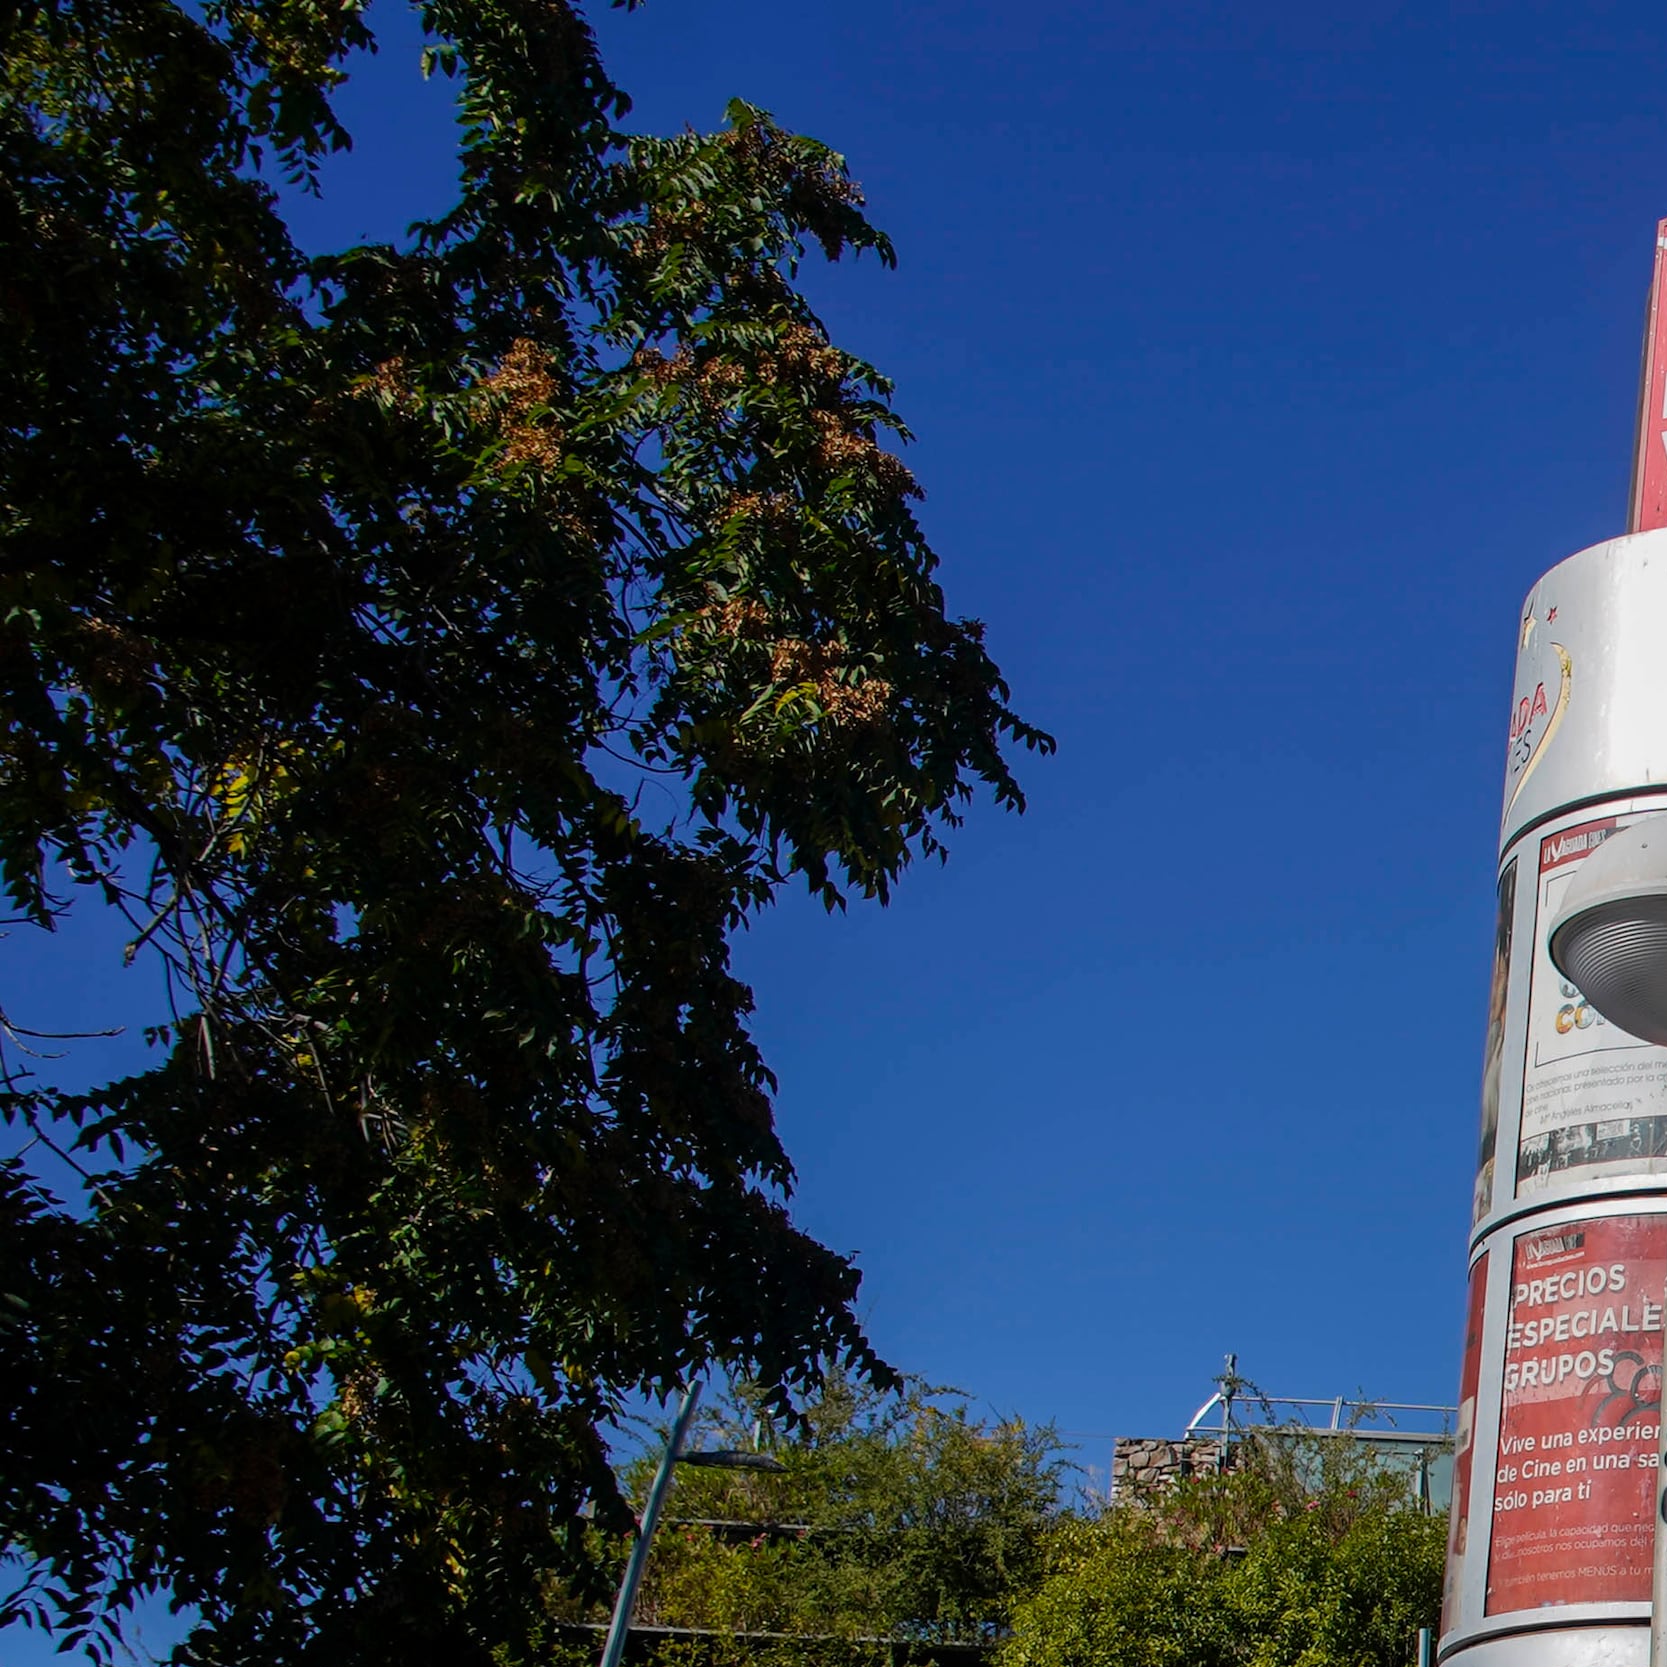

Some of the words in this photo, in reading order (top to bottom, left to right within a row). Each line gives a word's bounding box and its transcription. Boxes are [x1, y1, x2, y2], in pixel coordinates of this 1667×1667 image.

[1626, 1074, 1644, 1085] por
[1513, 1264, 1626, 1309] PRECIOS
[1507, 1304, 1665, 1350] ESPECIALE
[1504, 1349, 1615, 1391] GRUPOS
[1500, 1435, 1535, 1455] Vive
[1541, 1430, 1573, 1449] una
[1497, 1465, 1517, 1484] de
[1521, 1460, 1561, 1479] Cine
[1566, 1457, 1587, 1473] en
[1592, 1453, 1630, 1470] una
[1494, 1490, 1527, 1512] sólo
[1532, 1486, 1572, 1509] para
[1577, 1479, 1592, 1499] ti
[1555, 1541, 1572, 1551] nos
[1574, 1535, 1628, 1550] ocupamos
[1610, 1523, 1633, 1536] que
